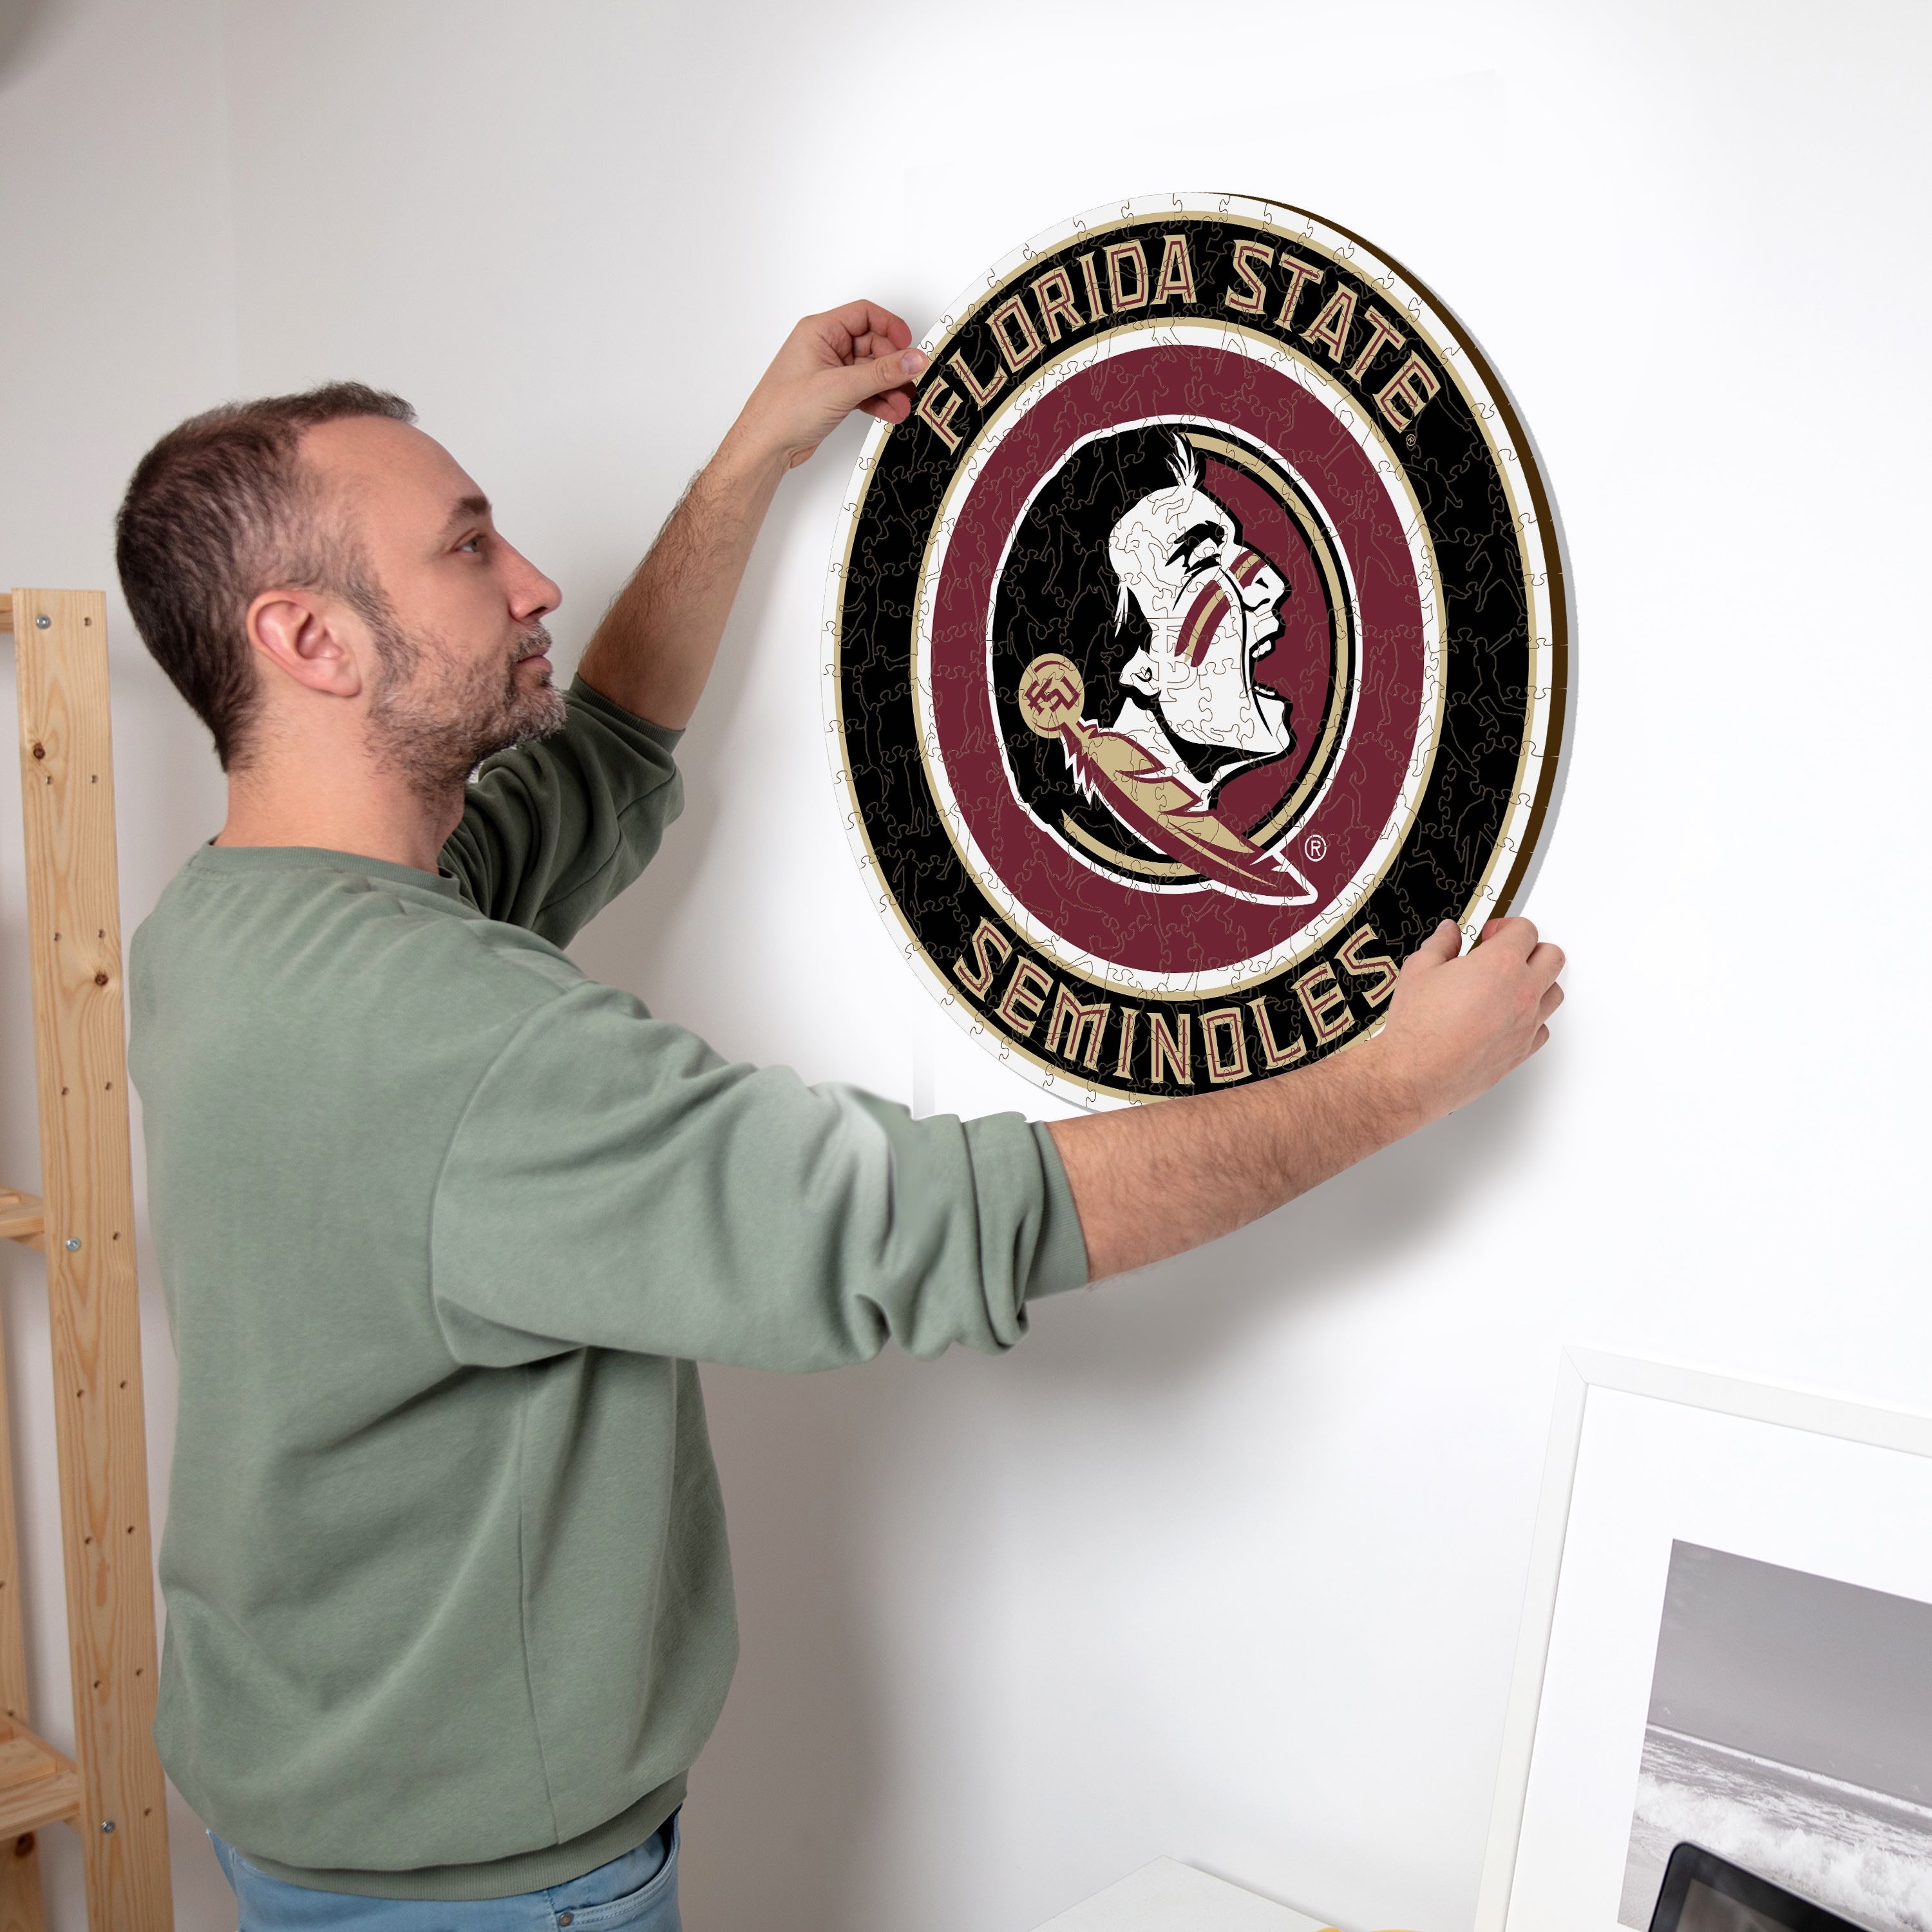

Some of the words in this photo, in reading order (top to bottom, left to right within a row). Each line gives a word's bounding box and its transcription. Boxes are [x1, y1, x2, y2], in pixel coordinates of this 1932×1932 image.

[914, 234, 1197, 456] FLORIDA
[1225, 240, 1441, 433] STATE
[953, 916, 1400, 1086] SEMINOLES
